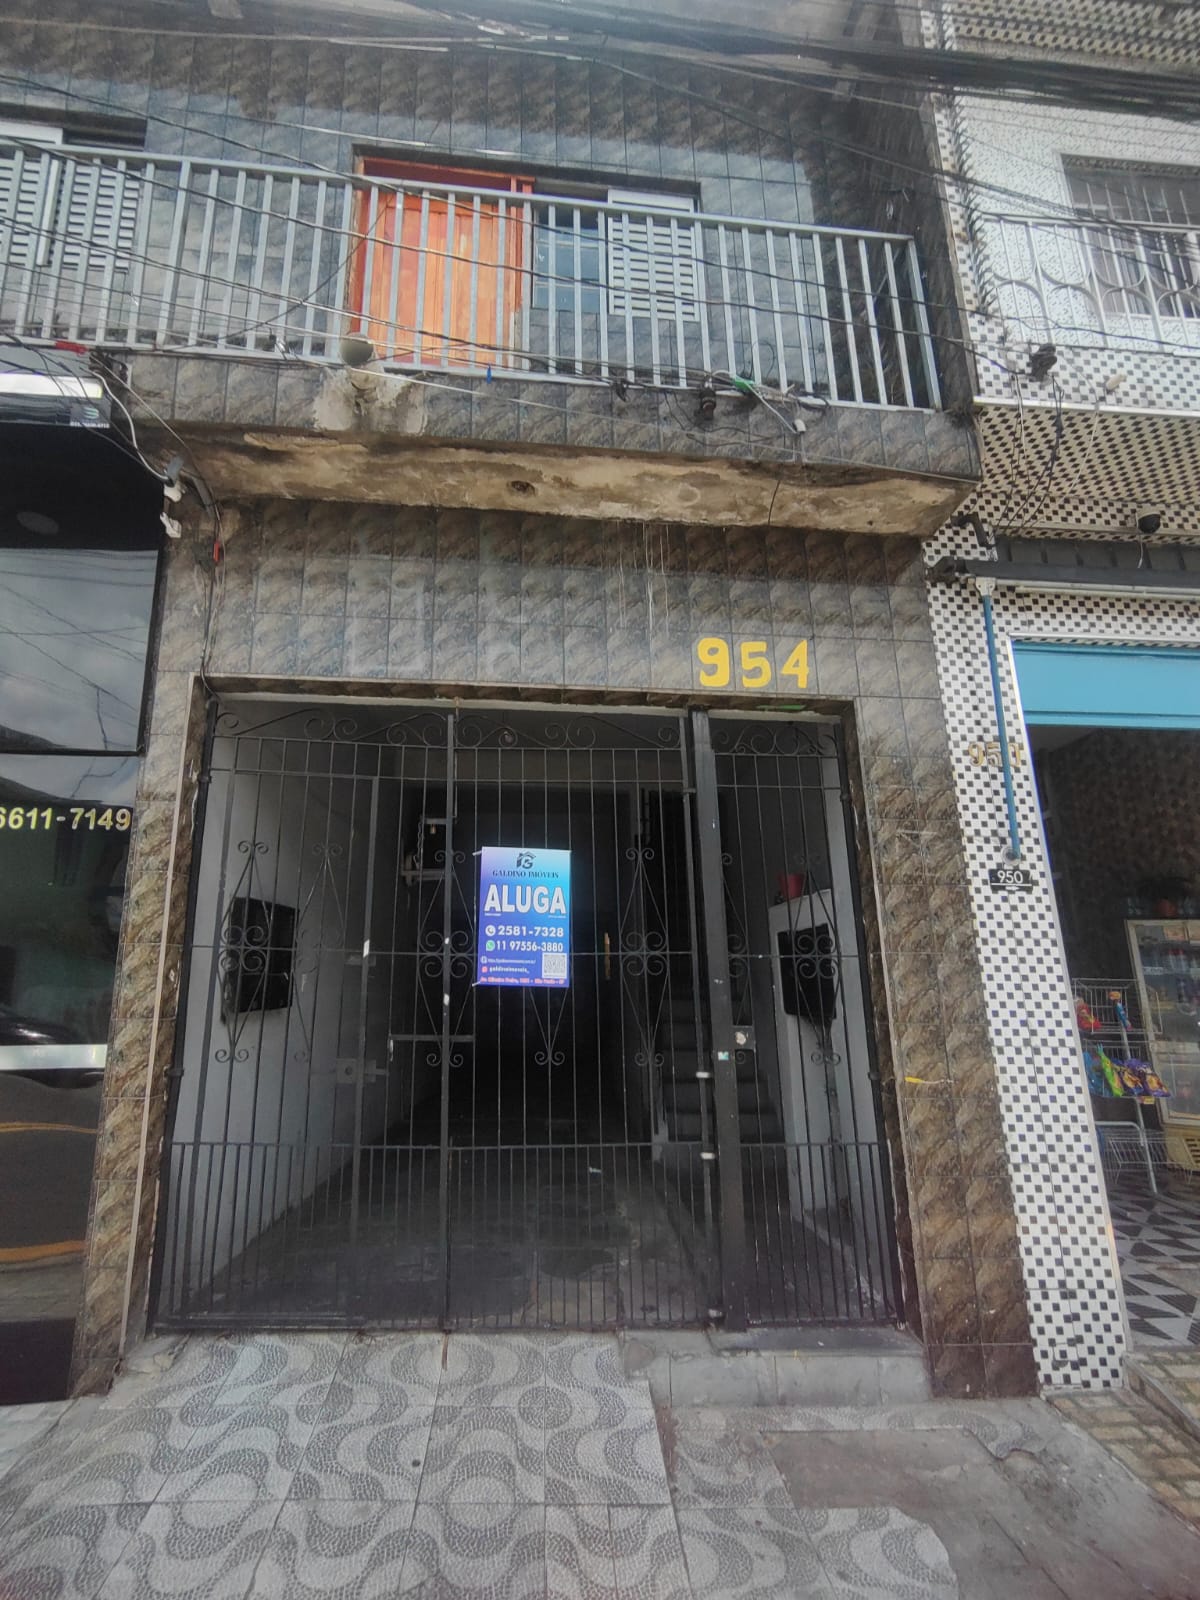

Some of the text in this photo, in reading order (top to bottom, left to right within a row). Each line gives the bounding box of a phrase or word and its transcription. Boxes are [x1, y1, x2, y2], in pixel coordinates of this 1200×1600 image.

[697, 637, 809, 689] 954
[492, 870, 526, 878] GALDINO
[997, 870, 1024, 884] 950
[484, 884, 567, 915] ALUGA
[497, 924, 564, 938] 2581-7328
[496, 940, 506, 951] 11
